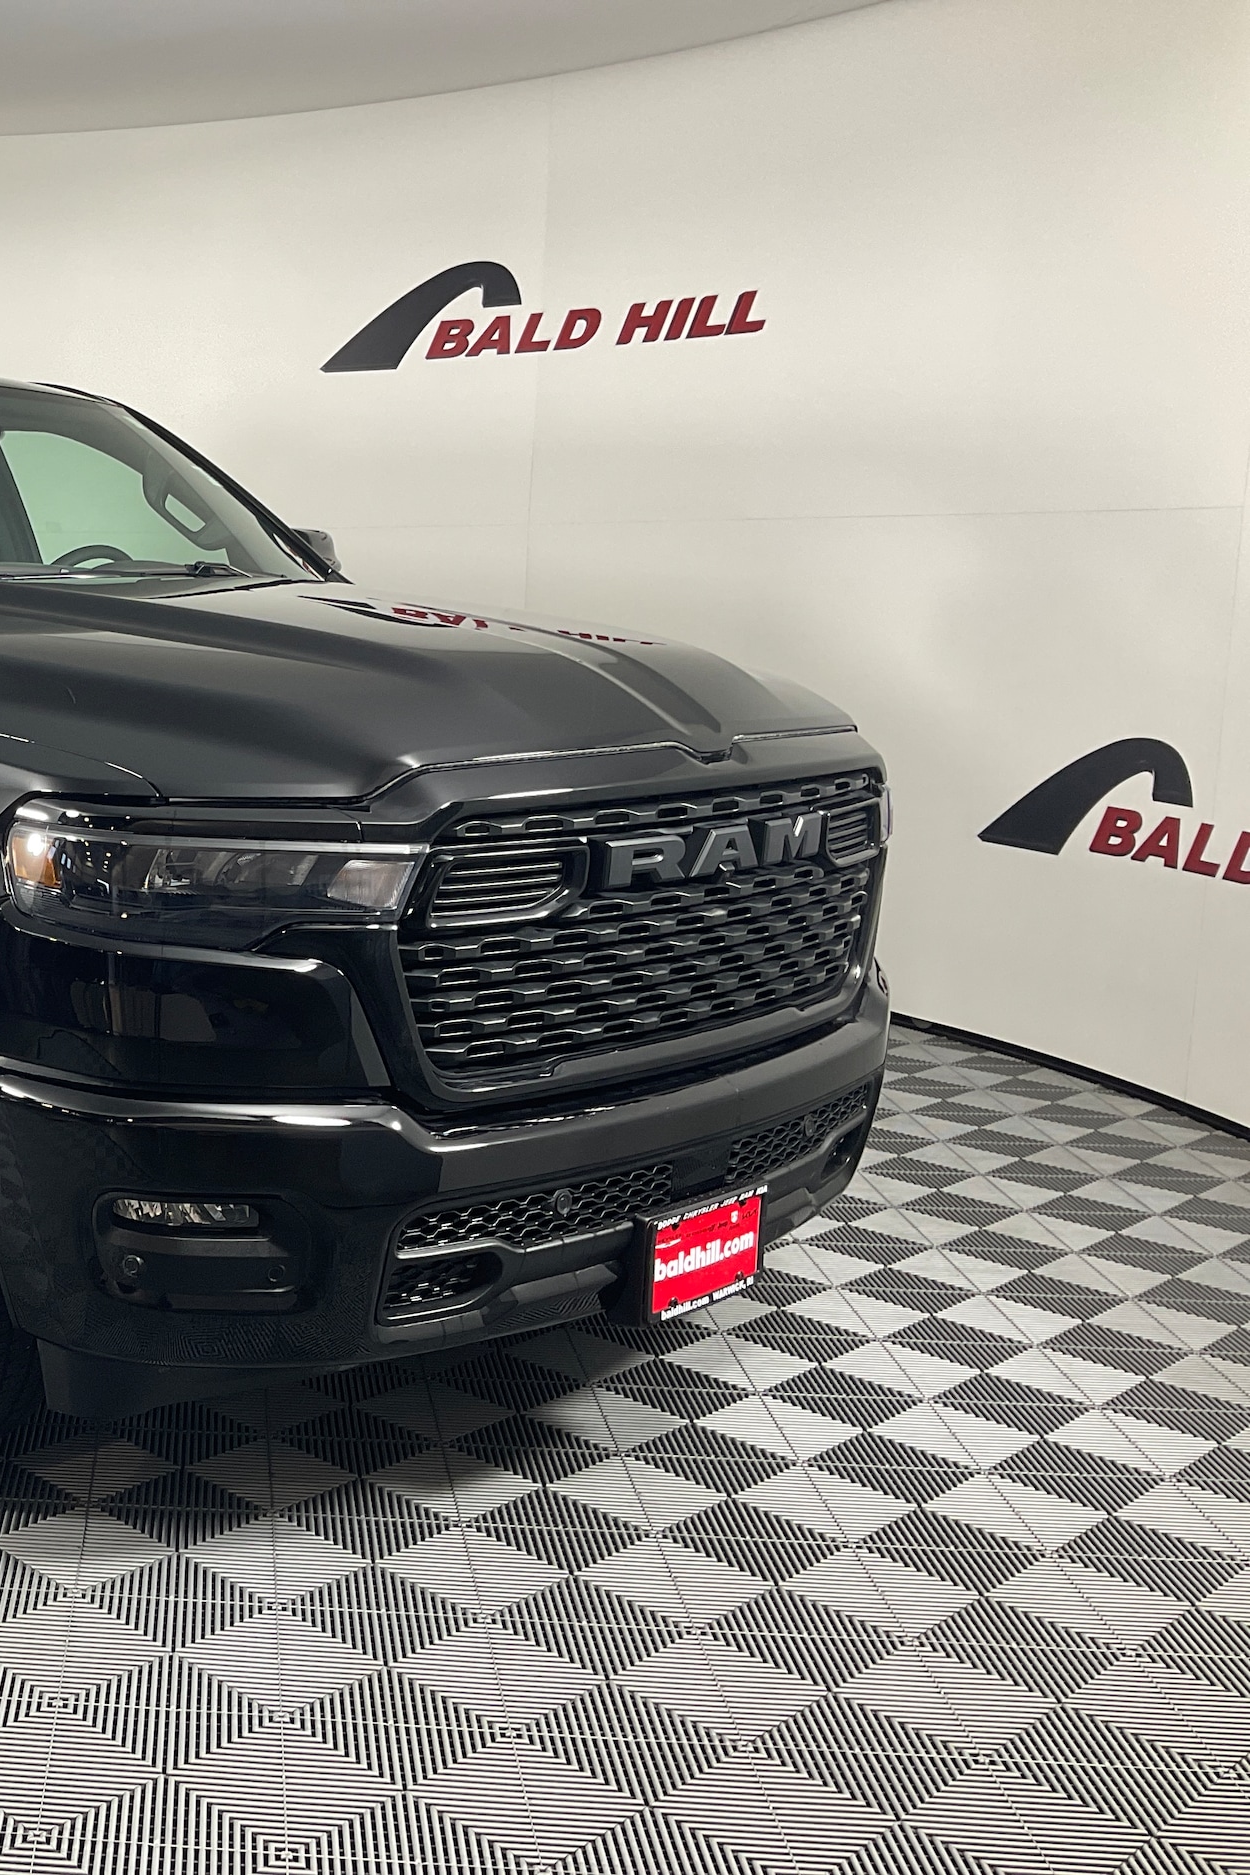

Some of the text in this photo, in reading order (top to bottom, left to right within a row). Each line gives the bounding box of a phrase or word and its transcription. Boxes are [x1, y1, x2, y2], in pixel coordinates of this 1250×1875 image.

[425, 290, 766, 360] BALD HILL
[605, 811, 824, 888] RAM
[657, 1215, 681, 1230] DODGE
[683, 1202, 719, 1220] CHRYSLER
[720, 1196, 737, 1208] JEEP
[756, 1185, 768, 1196] KIA
[654, 1231, 754, 1282] baldhill.com
[661, 1296, 710, 1320] baldhill.com
